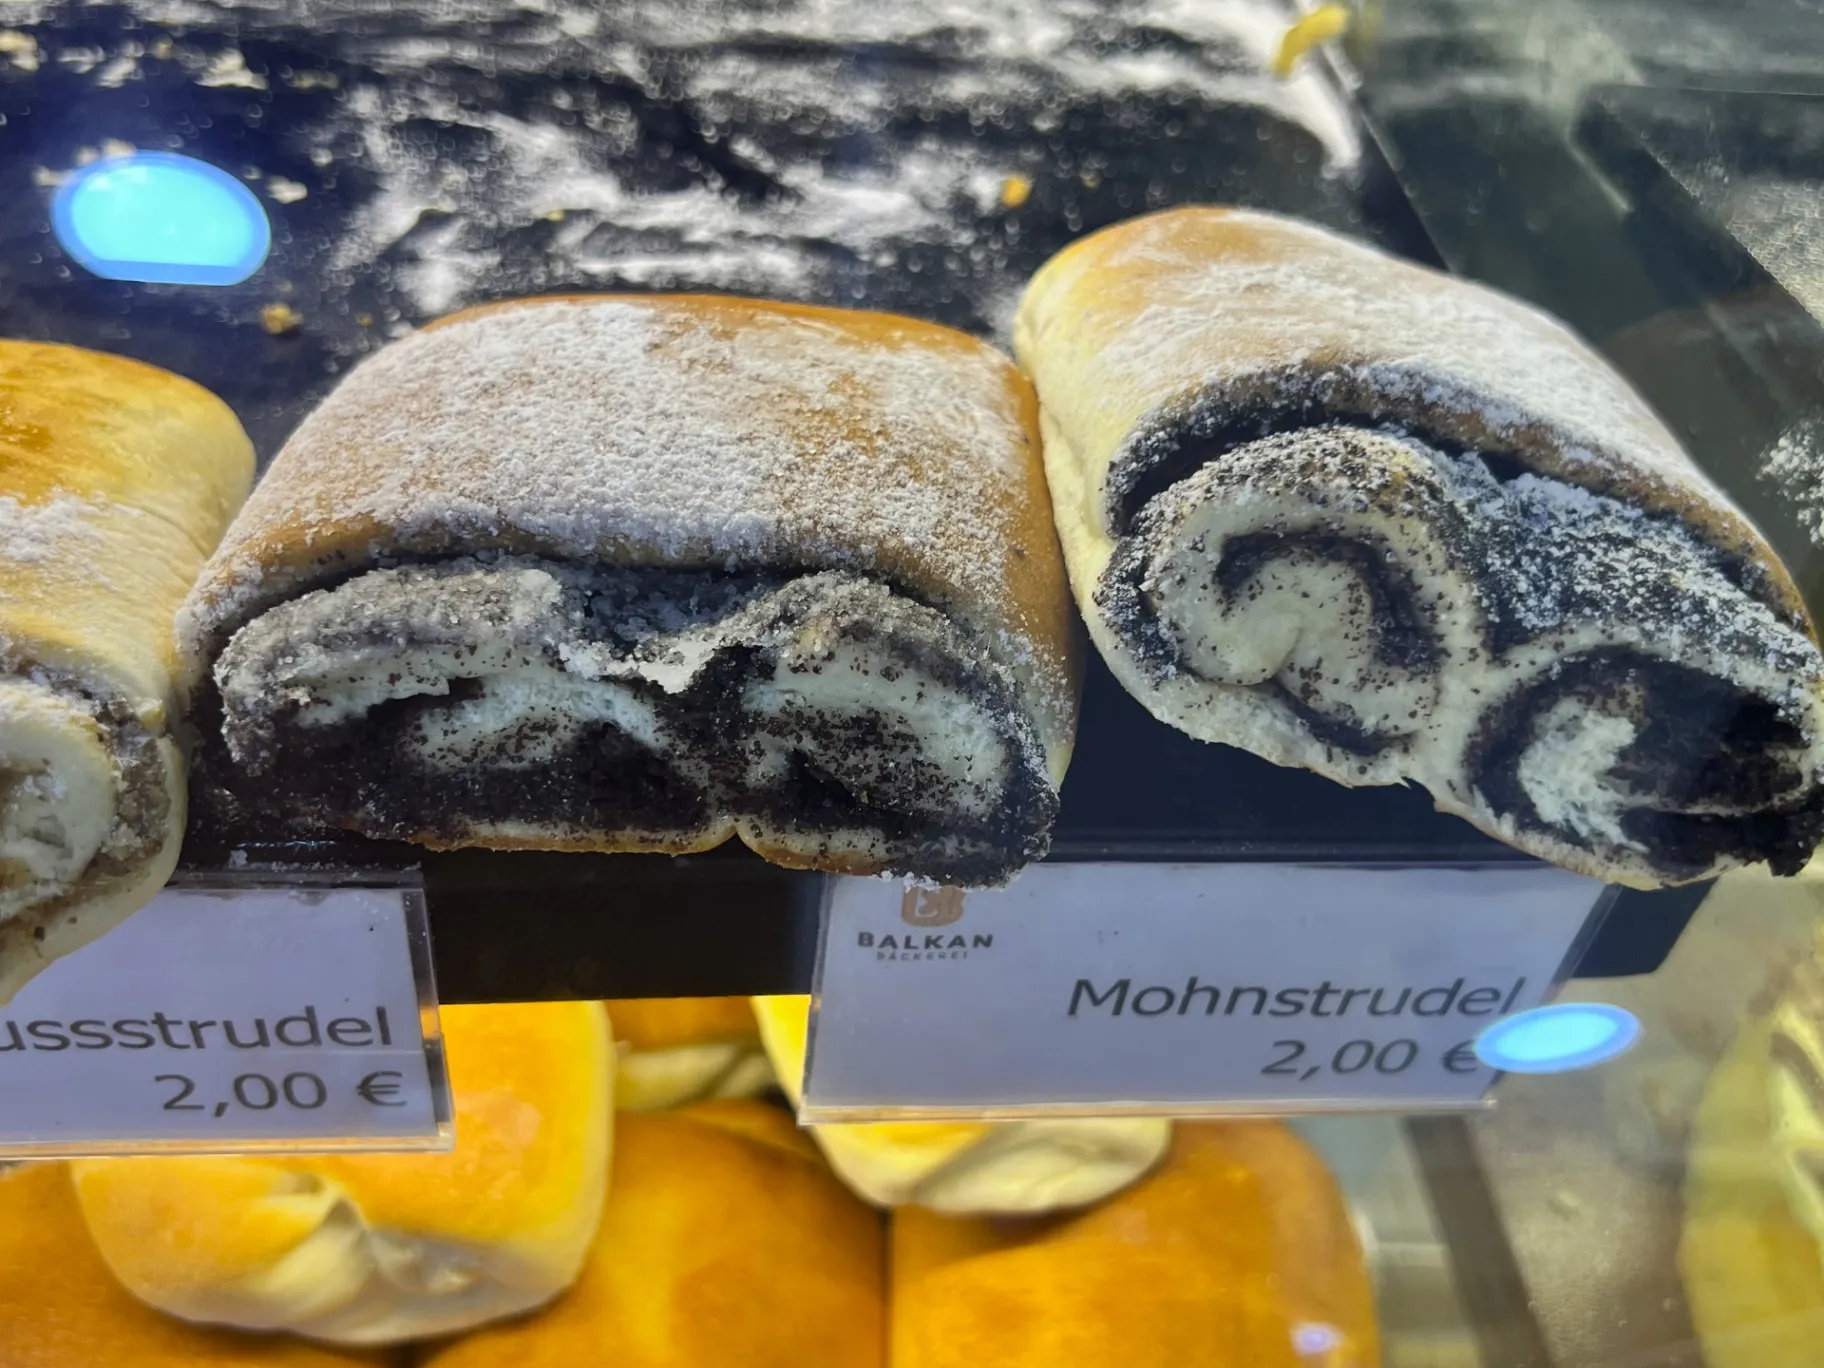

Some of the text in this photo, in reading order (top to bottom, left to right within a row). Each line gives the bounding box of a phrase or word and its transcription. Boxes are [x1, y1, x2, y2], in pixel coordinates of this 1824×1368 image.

[857, 931, 994, 950] BALKAN
[1067, 976, 1526, 1018] Mohnstrudel
[1260, 1039, 1478, 1082] 2,00 €
[154, 1070, 408, 1118] 2,00 €
